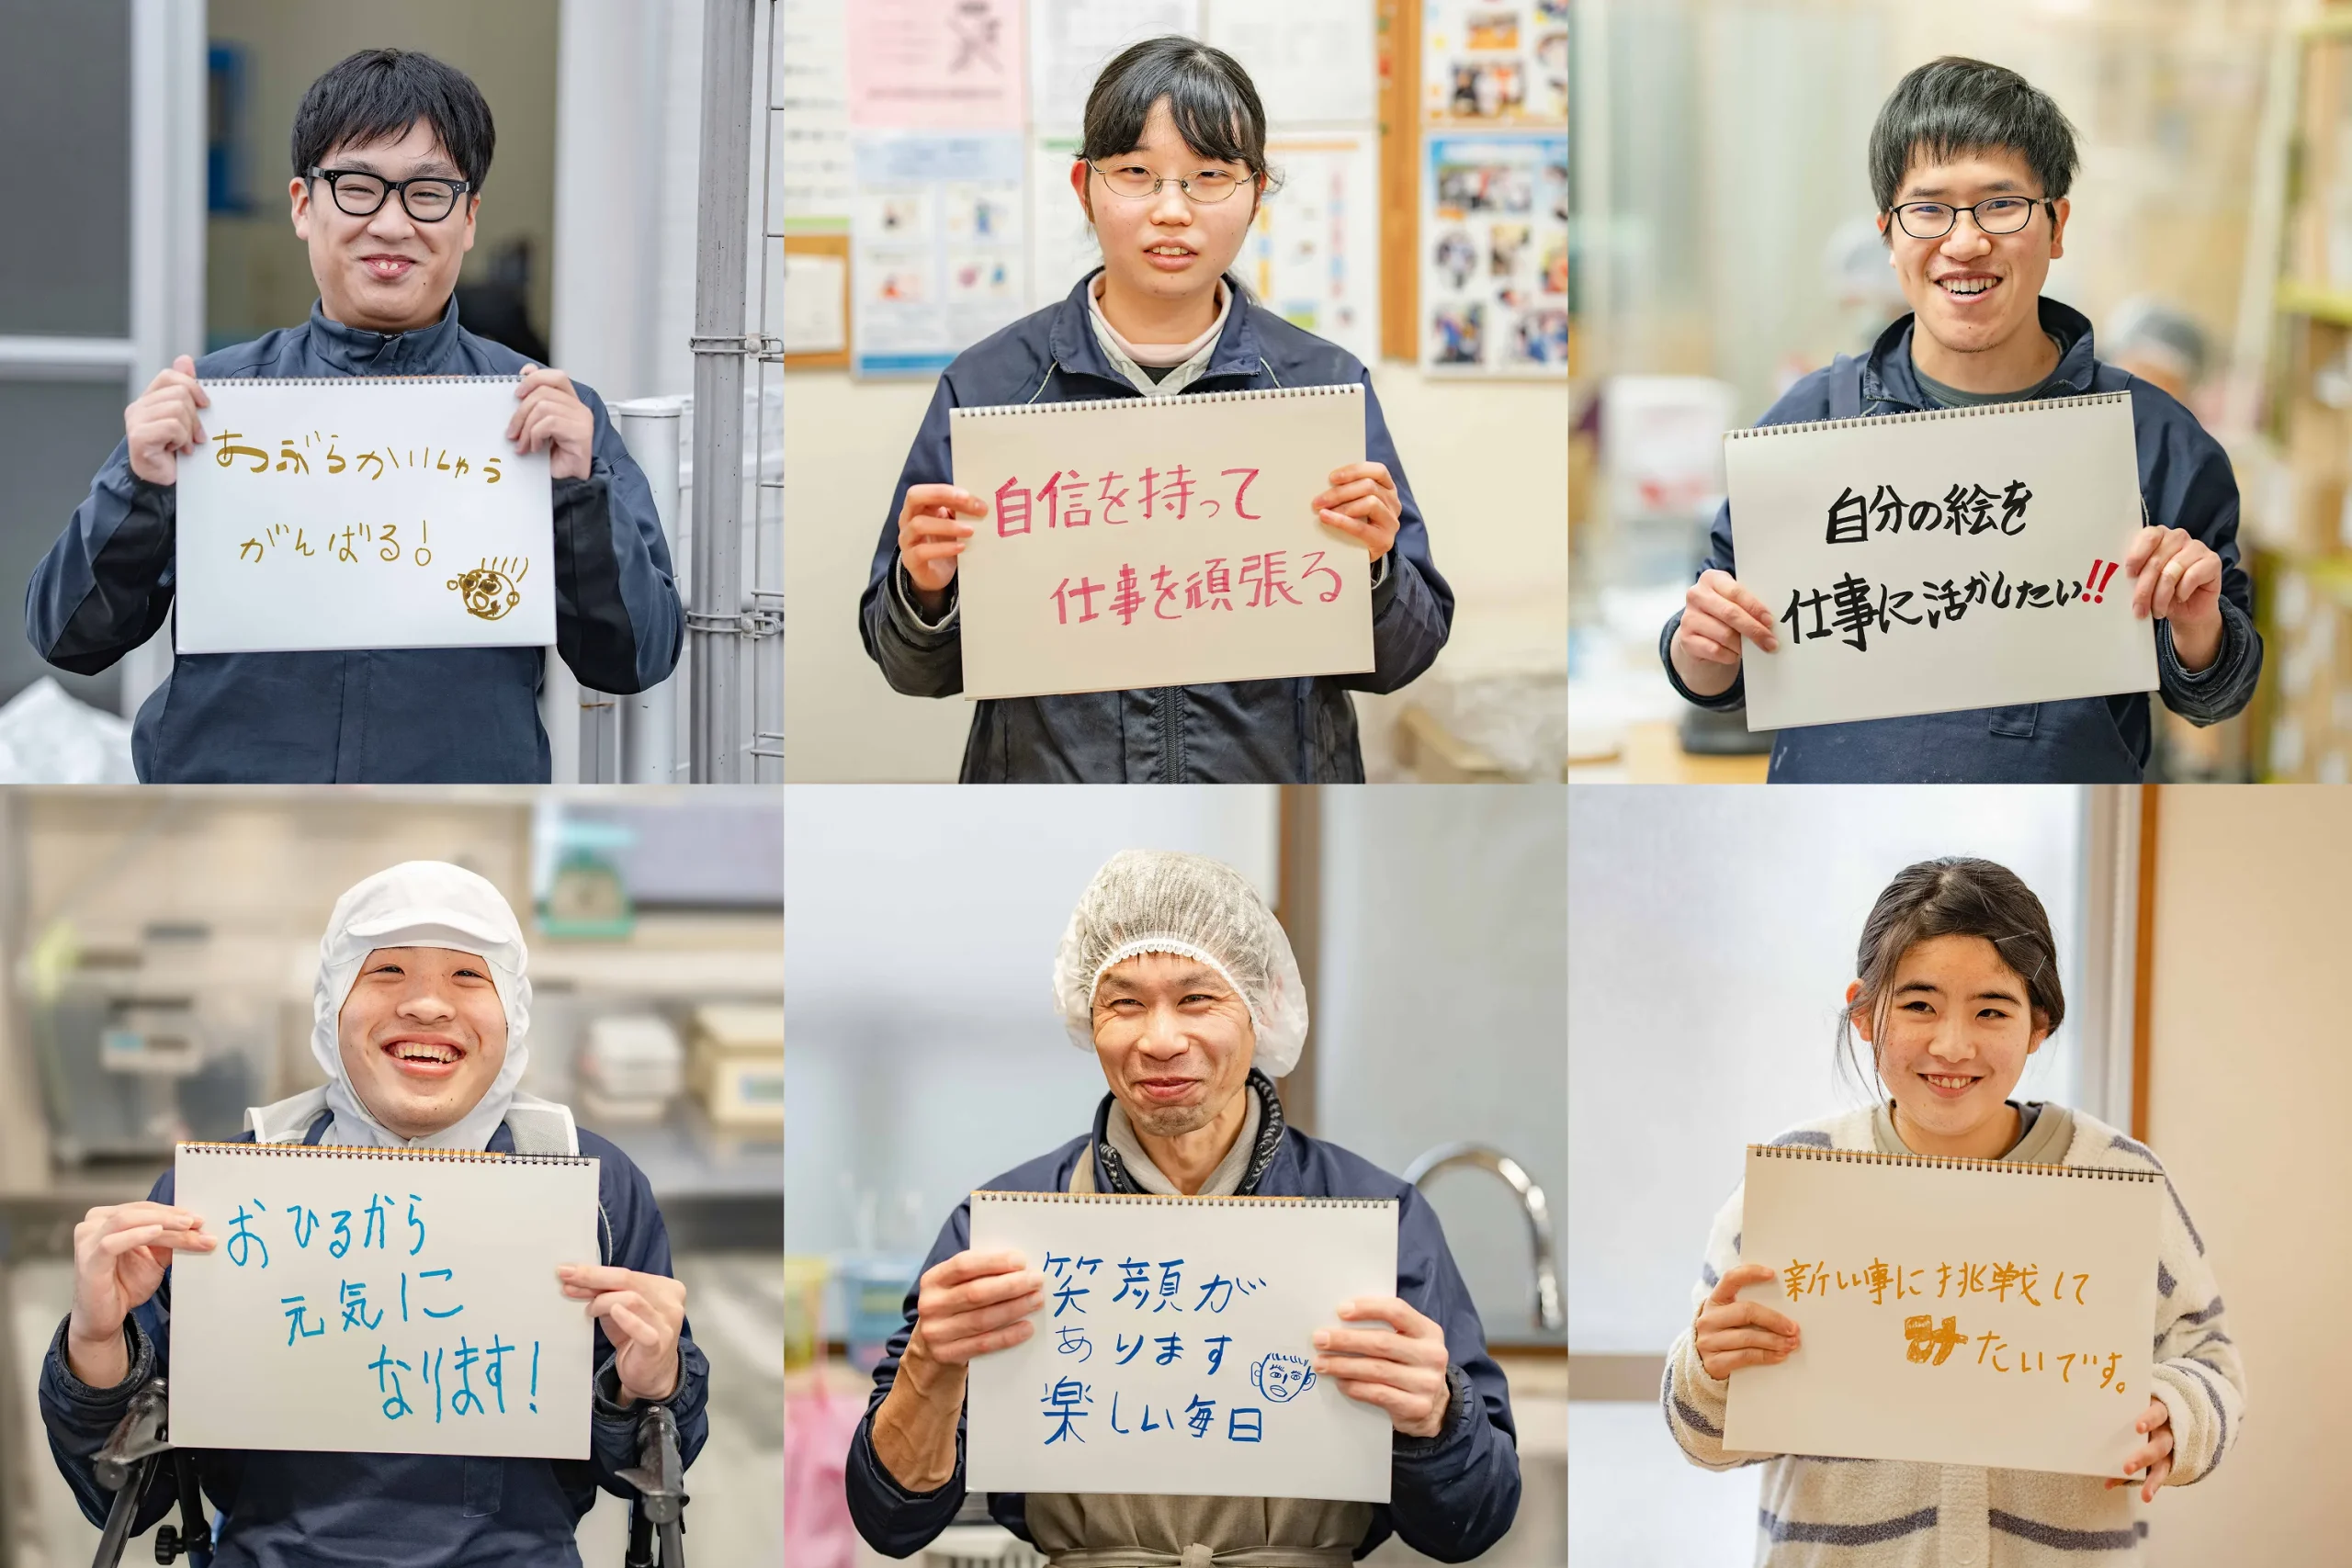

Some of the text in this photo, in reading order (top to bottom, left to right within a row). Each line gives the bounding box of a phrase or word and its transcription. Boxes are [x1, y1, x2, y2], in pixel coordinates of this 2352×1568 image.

[994, 464, 1261, 538] 自信を持って
[1825, 479, 2034, 545] 自分の絵を
[1049, 550, 1343, 626] 仕事を頑張る
[227, 1192, 425, 1269] おひるから
[280, 1268, 464, 1347] 元気に
[1042, 1251, 1268, 1318] 笑顔が
[1783, 1257, 2090, 1307] 新しい事に挑戦して
[1055, 1325, 1233, 1376] あります
[1904, 1314, 2126, 1394] みたいです。
[1040, 1375, 1263, 1446] 楽しい毎日
